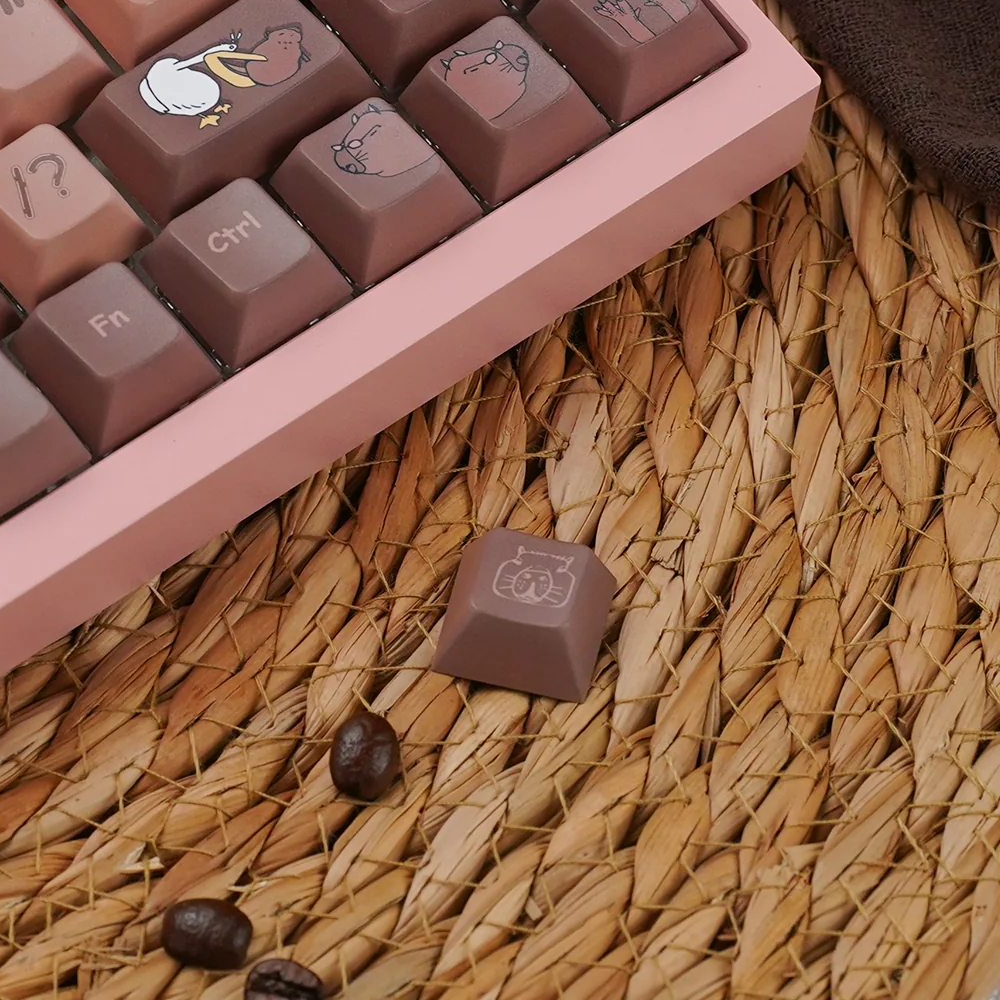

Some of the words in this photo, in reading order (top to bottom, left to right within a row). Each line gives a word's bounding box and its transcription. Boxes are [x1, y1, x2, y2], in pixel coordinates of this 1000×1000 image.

[26, 152, 70, 198] ?
[207, 210, 262, 253] Ctrl
[88, 308, 131, 338] Fn
